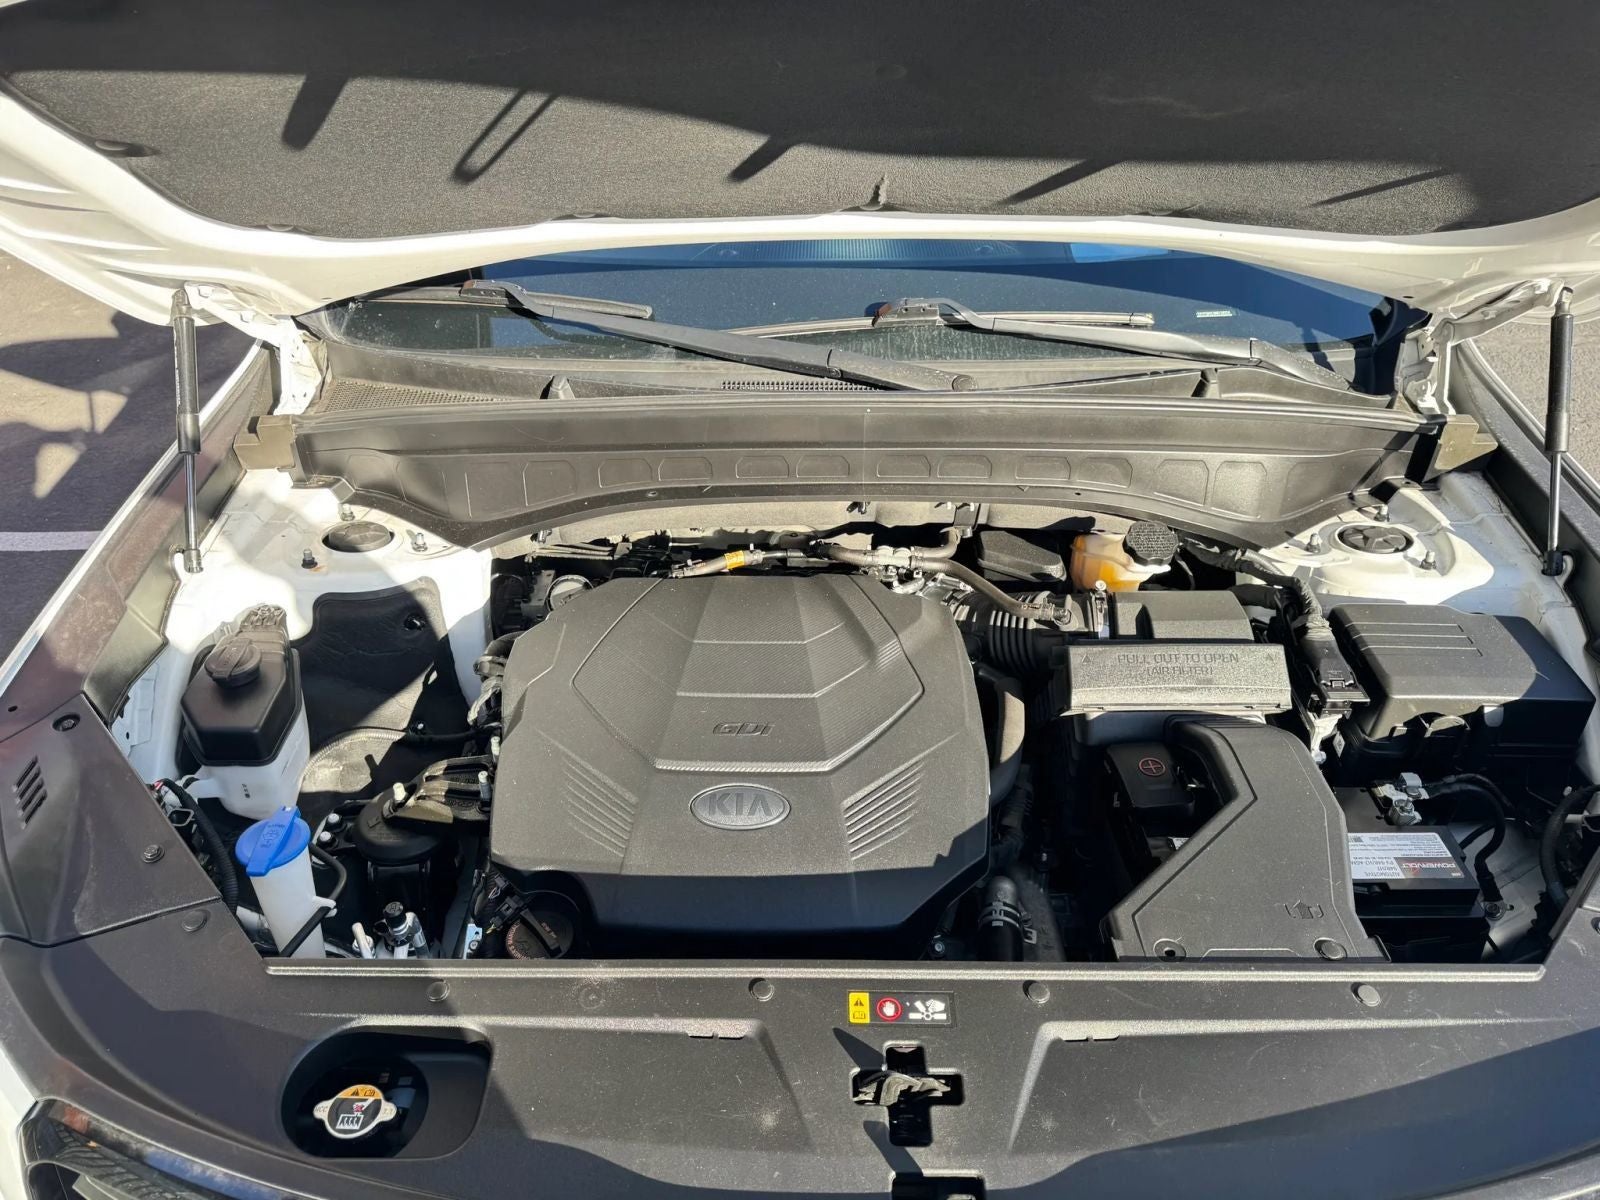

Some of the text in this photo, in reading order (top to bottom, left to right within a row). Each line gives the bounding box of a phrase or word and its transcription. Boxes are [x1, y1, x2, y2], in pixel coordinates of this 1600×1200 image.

[1117, 653, 1239, 664] PULL OUT TO OPEN
[707, 792, 773, 817] KIA
